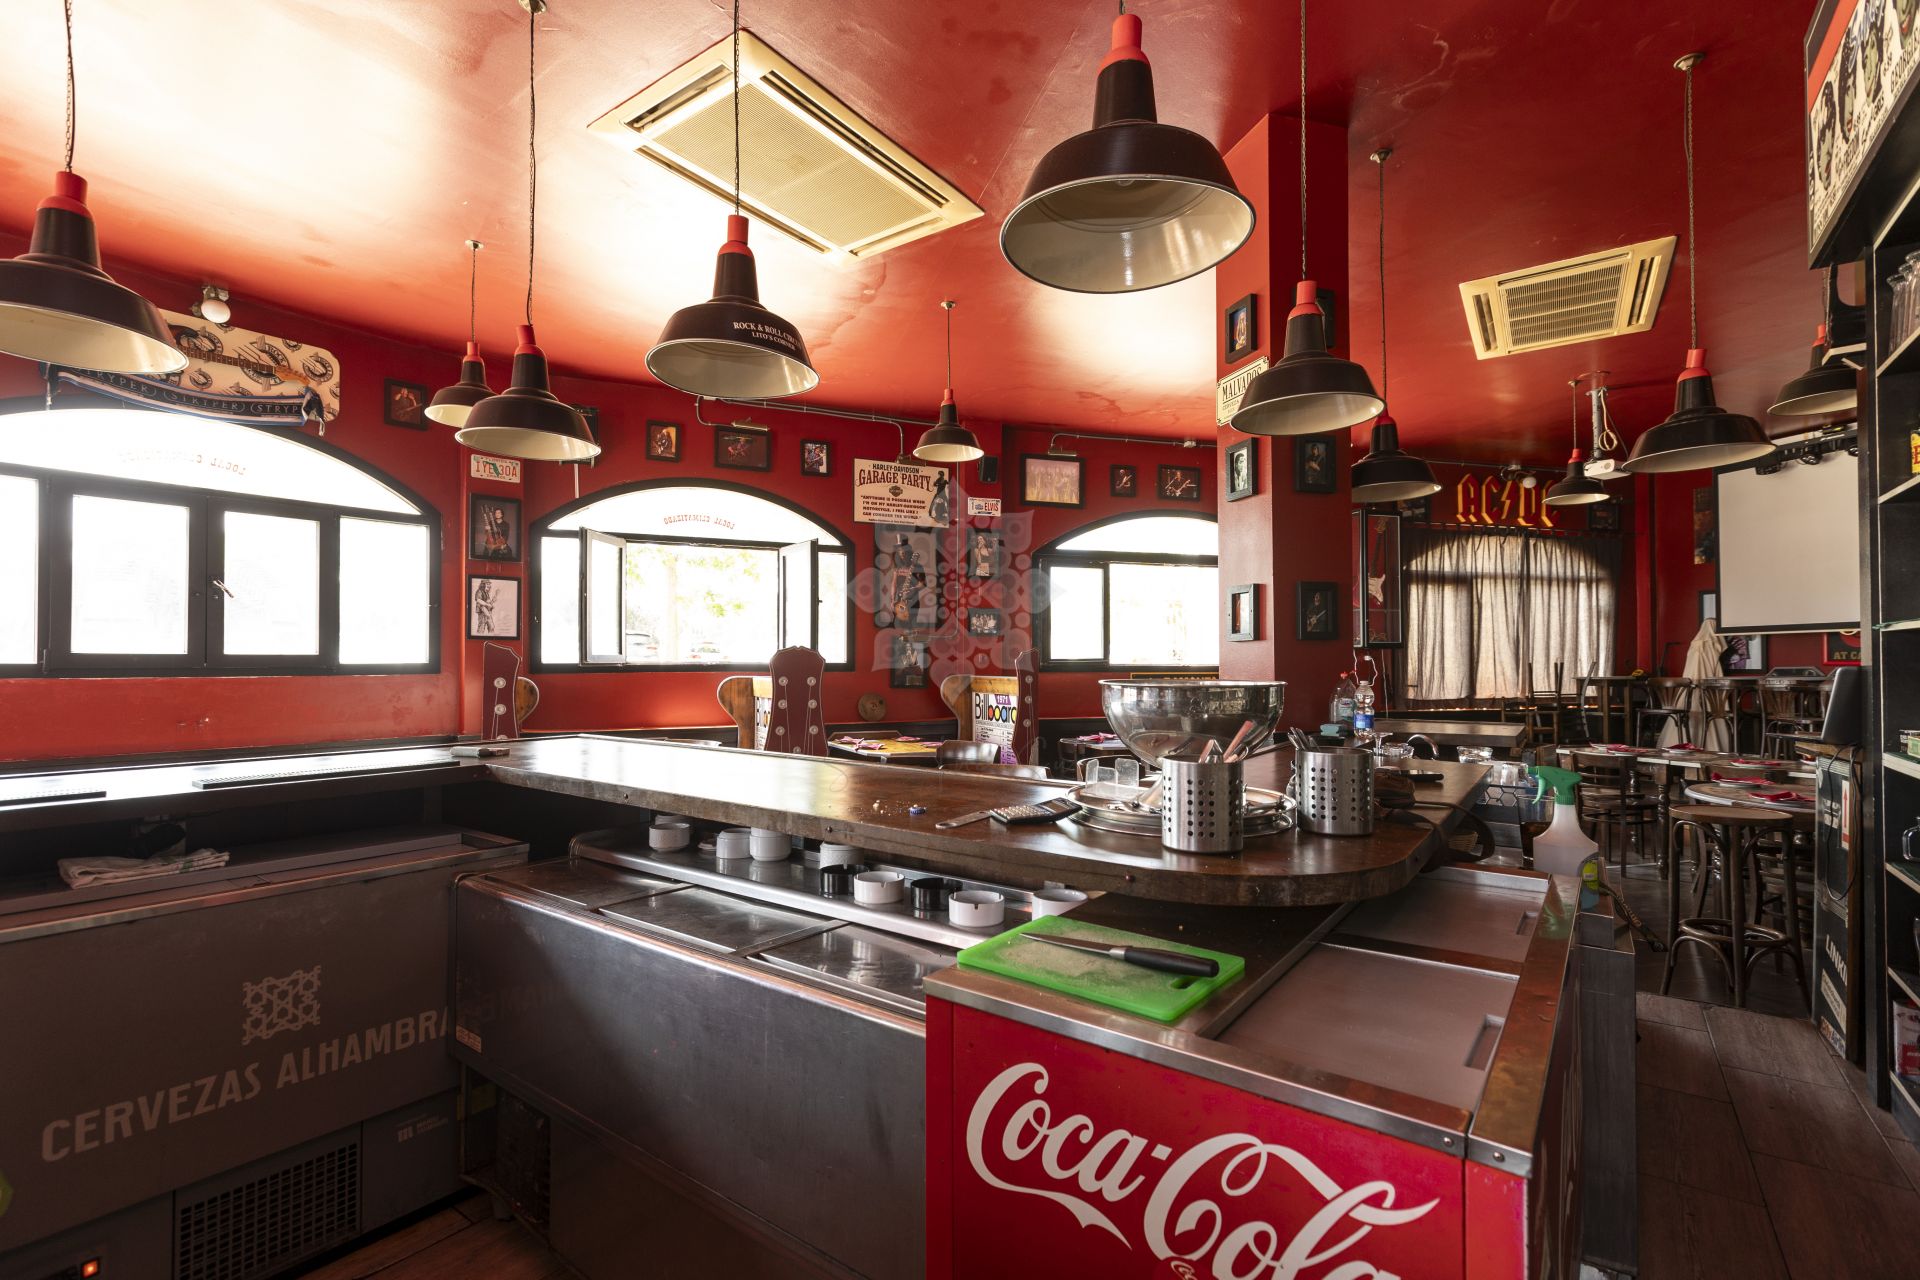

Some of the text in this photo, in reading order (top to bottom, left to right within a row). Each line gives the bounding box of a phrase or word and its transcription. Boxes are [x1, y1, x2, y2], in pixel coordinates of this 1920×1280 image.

[733, 321, 757, 330] ROCK
[764, 325, 783, 337] ROLL
[256, 404, 299, 413] STRYP
[872, 463, 919, 474] HARLEY-DAVIDSON
[856, 468, 934, 492] GARAGE PARTY
[984, 502, 999, 511] ELVIS
[41, 1062, 262, 1162] CERVEZAS
